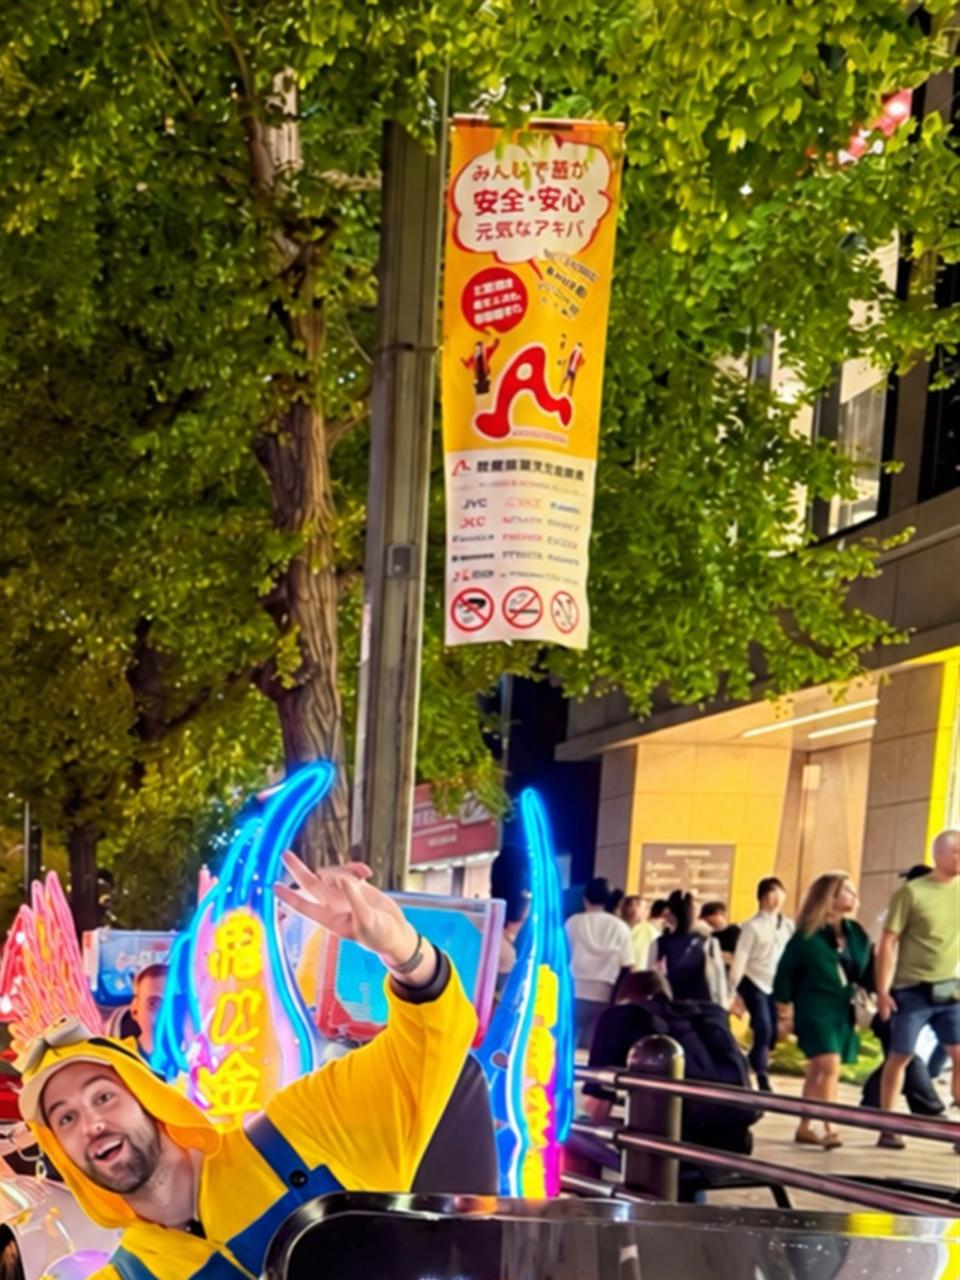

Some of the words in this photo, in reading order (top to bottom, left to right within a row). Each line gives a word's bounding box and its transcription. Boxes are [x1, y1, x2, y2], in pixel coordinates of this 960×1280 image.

[473, 186, 585, 217] 安全・安心
[475, 220, 585, 241] 元気なアキバ
